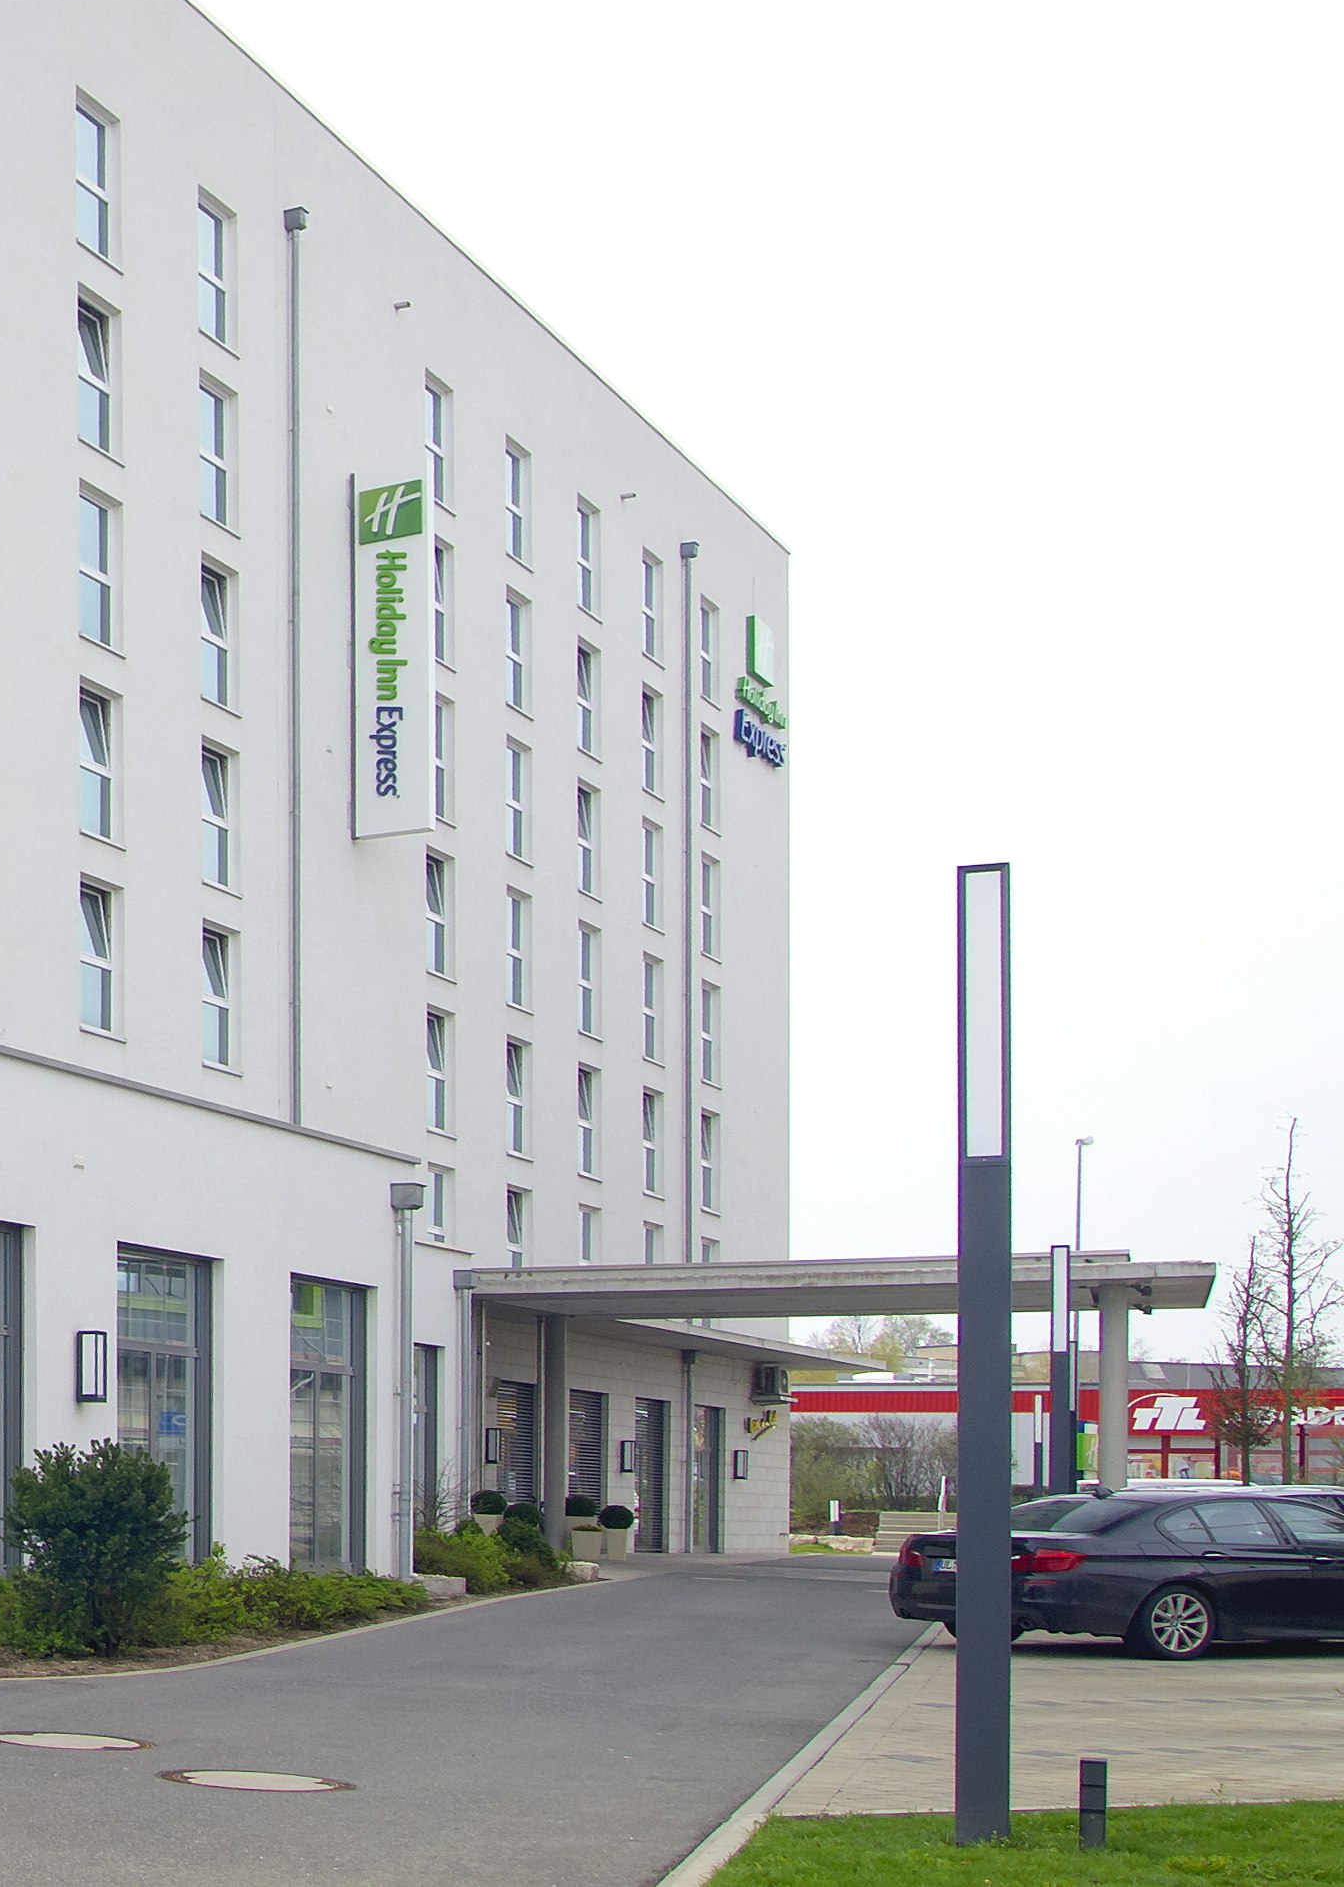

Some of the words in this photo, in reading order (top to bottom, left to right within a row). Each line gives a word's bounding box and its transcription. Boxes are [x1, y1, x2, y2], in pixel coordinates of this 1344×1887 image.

[368, 549, 408, 654] Holiday
[375, 659, 408, 701] Inn
[369, 705, 403, 798] Express
